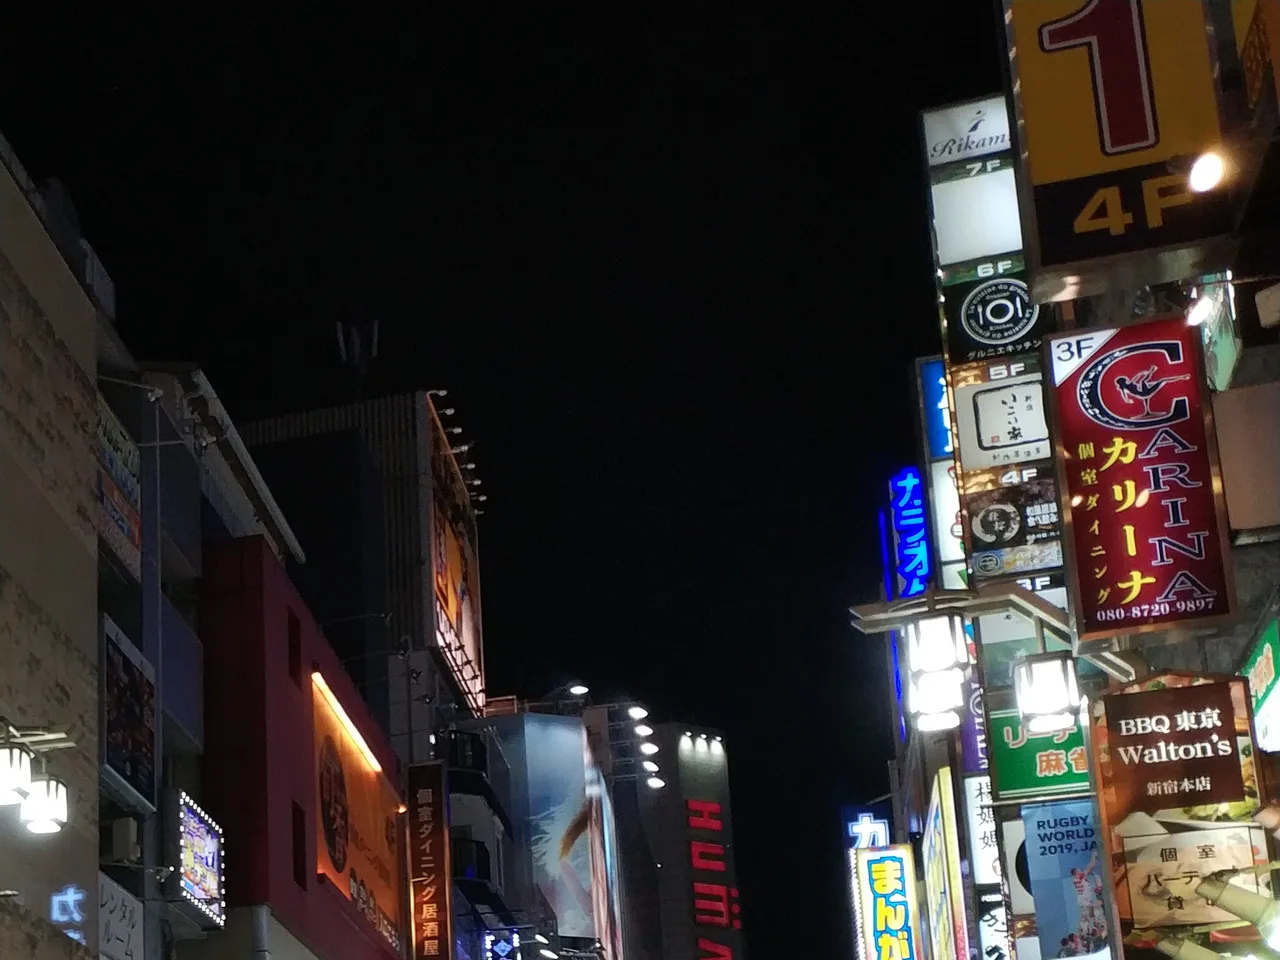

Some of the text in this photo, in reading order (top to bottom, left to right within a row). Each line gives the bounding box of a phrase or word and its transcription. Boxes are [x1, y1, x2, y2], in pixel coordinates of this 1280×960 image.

[965, 160, 1001, 176] 7F
[1074, 175, 1194, 236] 4F
[977, 260, 1012, 277] 6F
[1056, 337, 1095, 363] 3F
[989, 363, 1026, 381] 5F
[1000, 468, 1038, 485] 4F
[1078, 442, 1111, 606] 個室ダイニング
[1100, 437, 1156, 606] カリーナ
[1096, 598, 1215, 623] 080-8720-9897
[1119, 707, 1223, 736] BBQ 東京
[1118, 733, 1232, 765] Walton's
[1147, 776, 1211, 796] 新宿本店
[1037, 815, 1089, 830] RUGBY
[1038, 829, 1095, 843] WORLD
[1039, 843, 1078, 857] 2019,
[1160, 845, 1217, 862] 個室
[417, 789, 440, 956] 個室ダイニング居酒屋
[1146, 870, 1201, 889] パーテ
